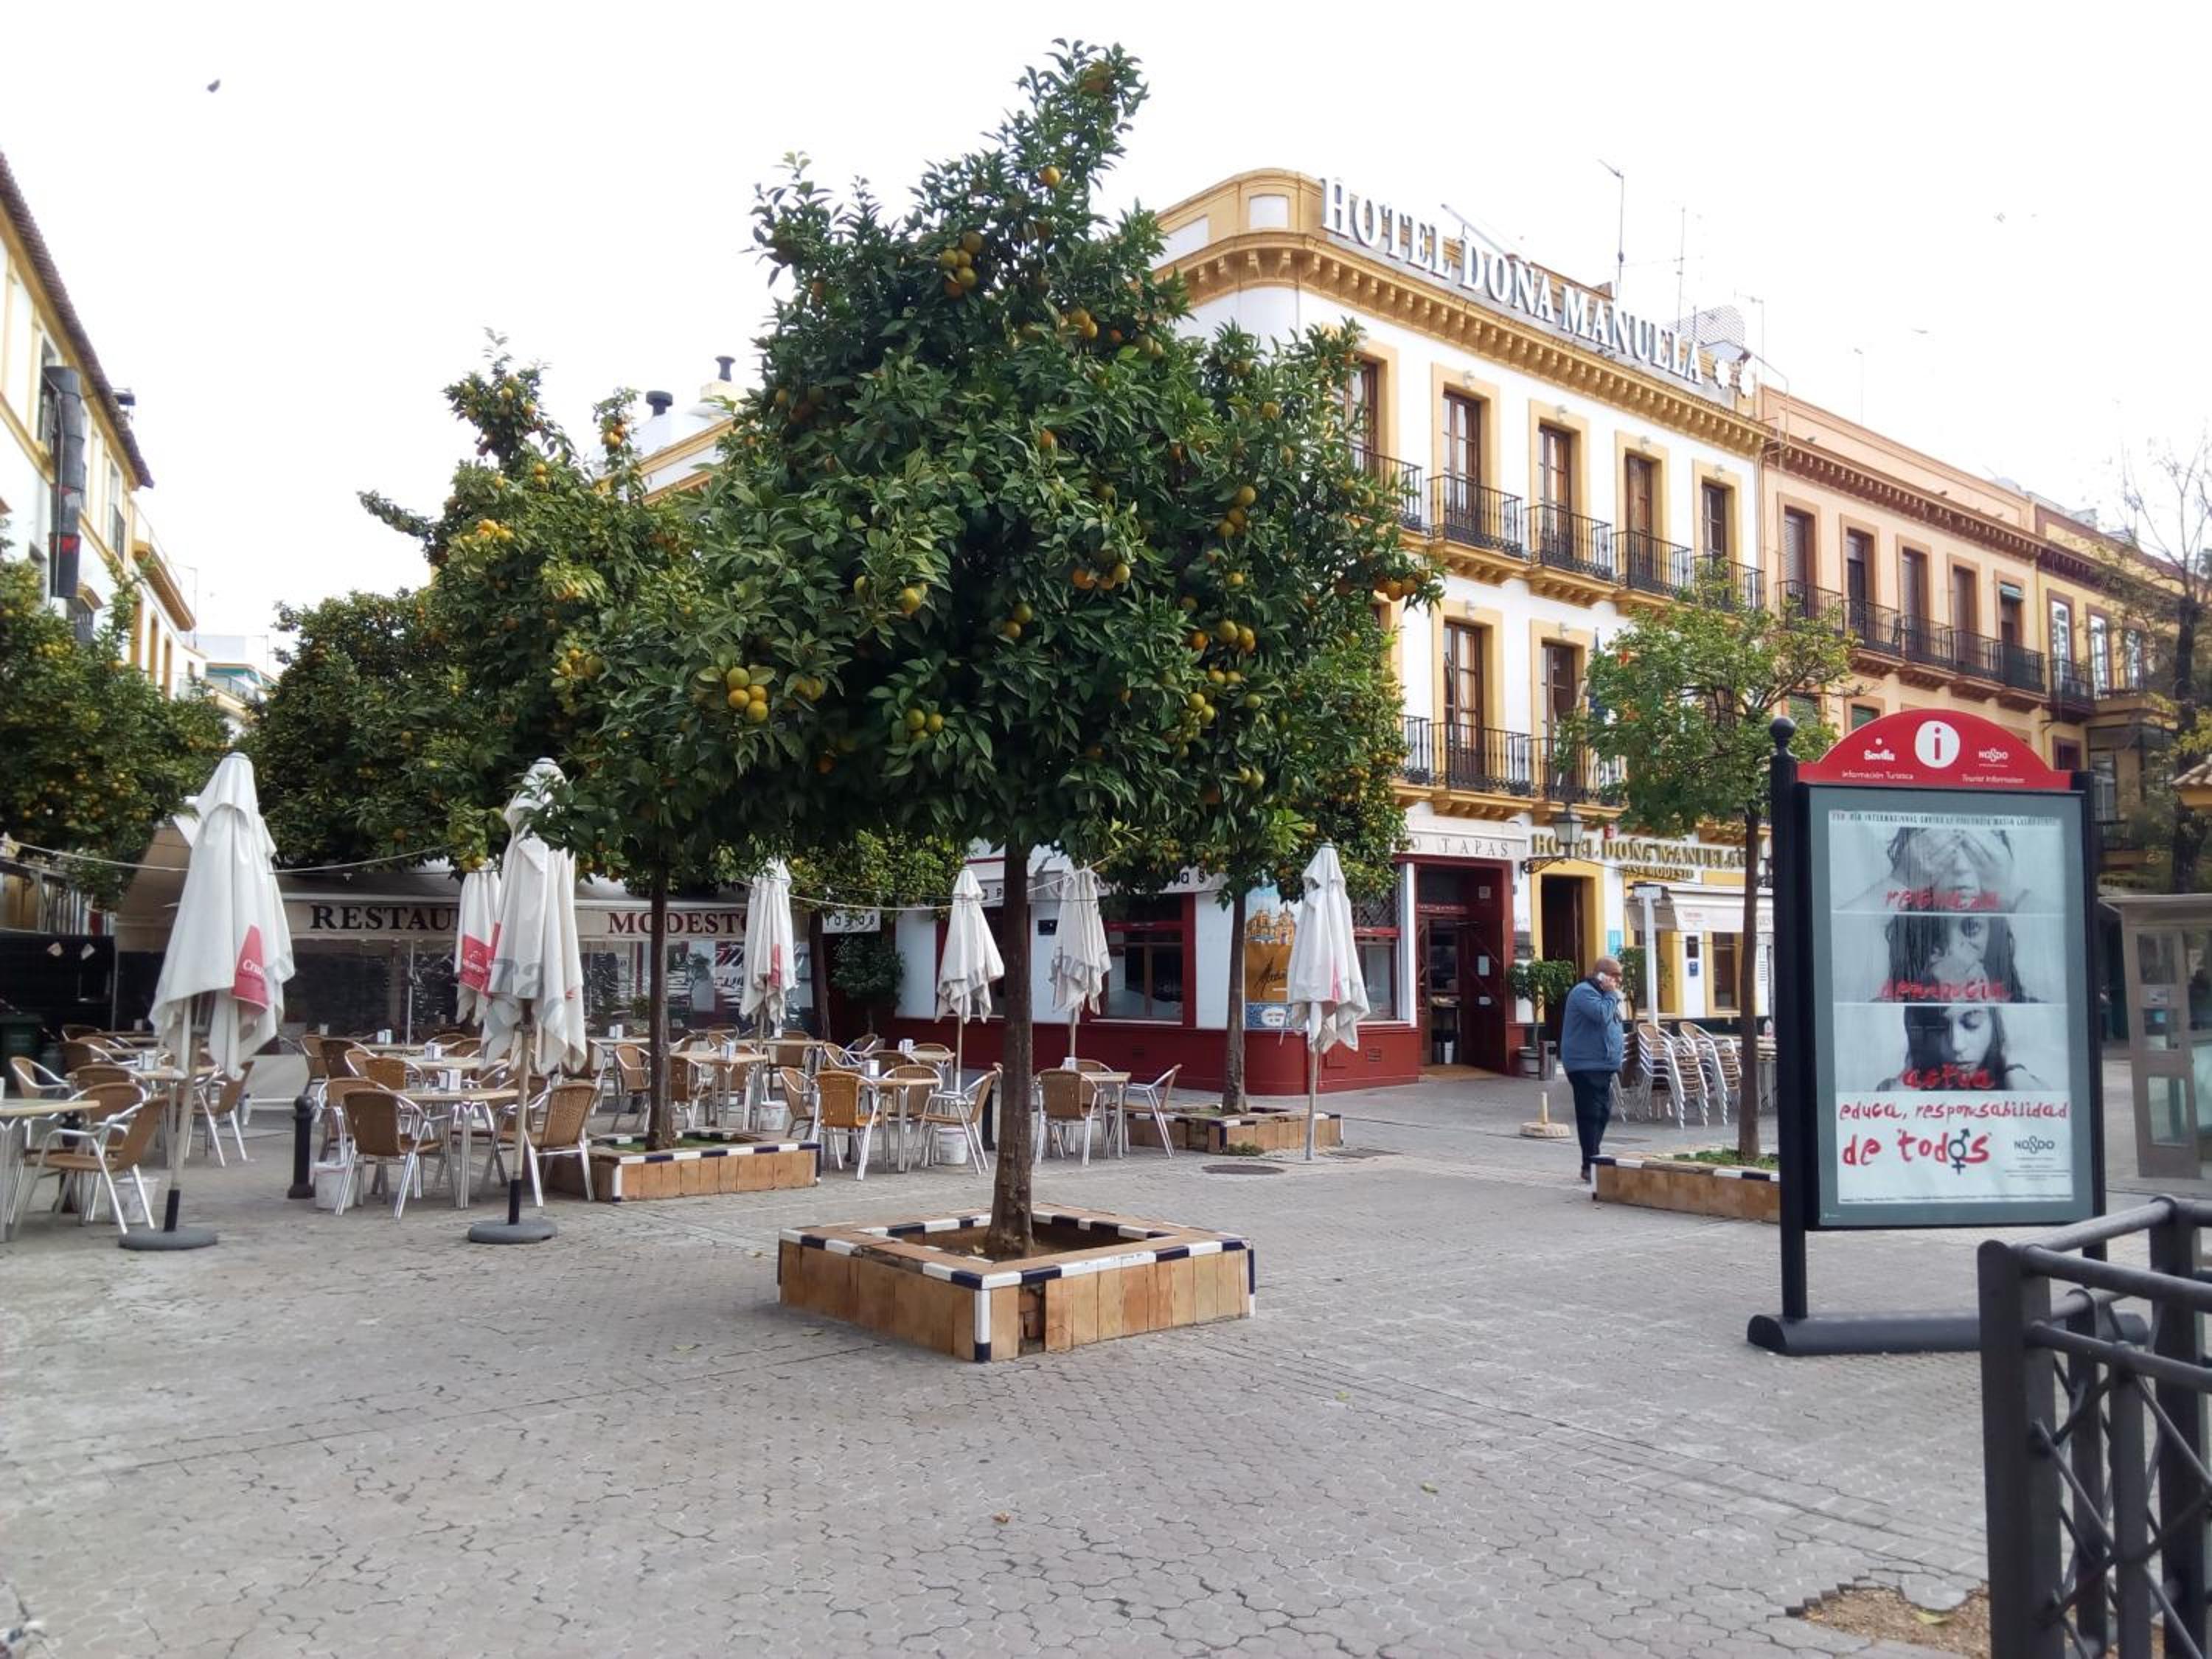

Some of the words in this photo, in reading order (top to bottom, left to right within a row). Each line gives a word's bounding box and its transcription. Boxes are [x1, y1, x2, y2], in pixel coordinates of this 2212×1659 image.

[1321, 178, 1453, 279] HOTEL
[1561, 285, 1705, 386] MANUELA
[1440, 837, 1509, 858] TAPAS
[310, 904, 459, 931] RESTAU
[1839, 1103, 1907, 1121] educa,
[1915, 1101, 2068, 1124] responsabilidad
[1841, 1134, 1882, 1166] de
